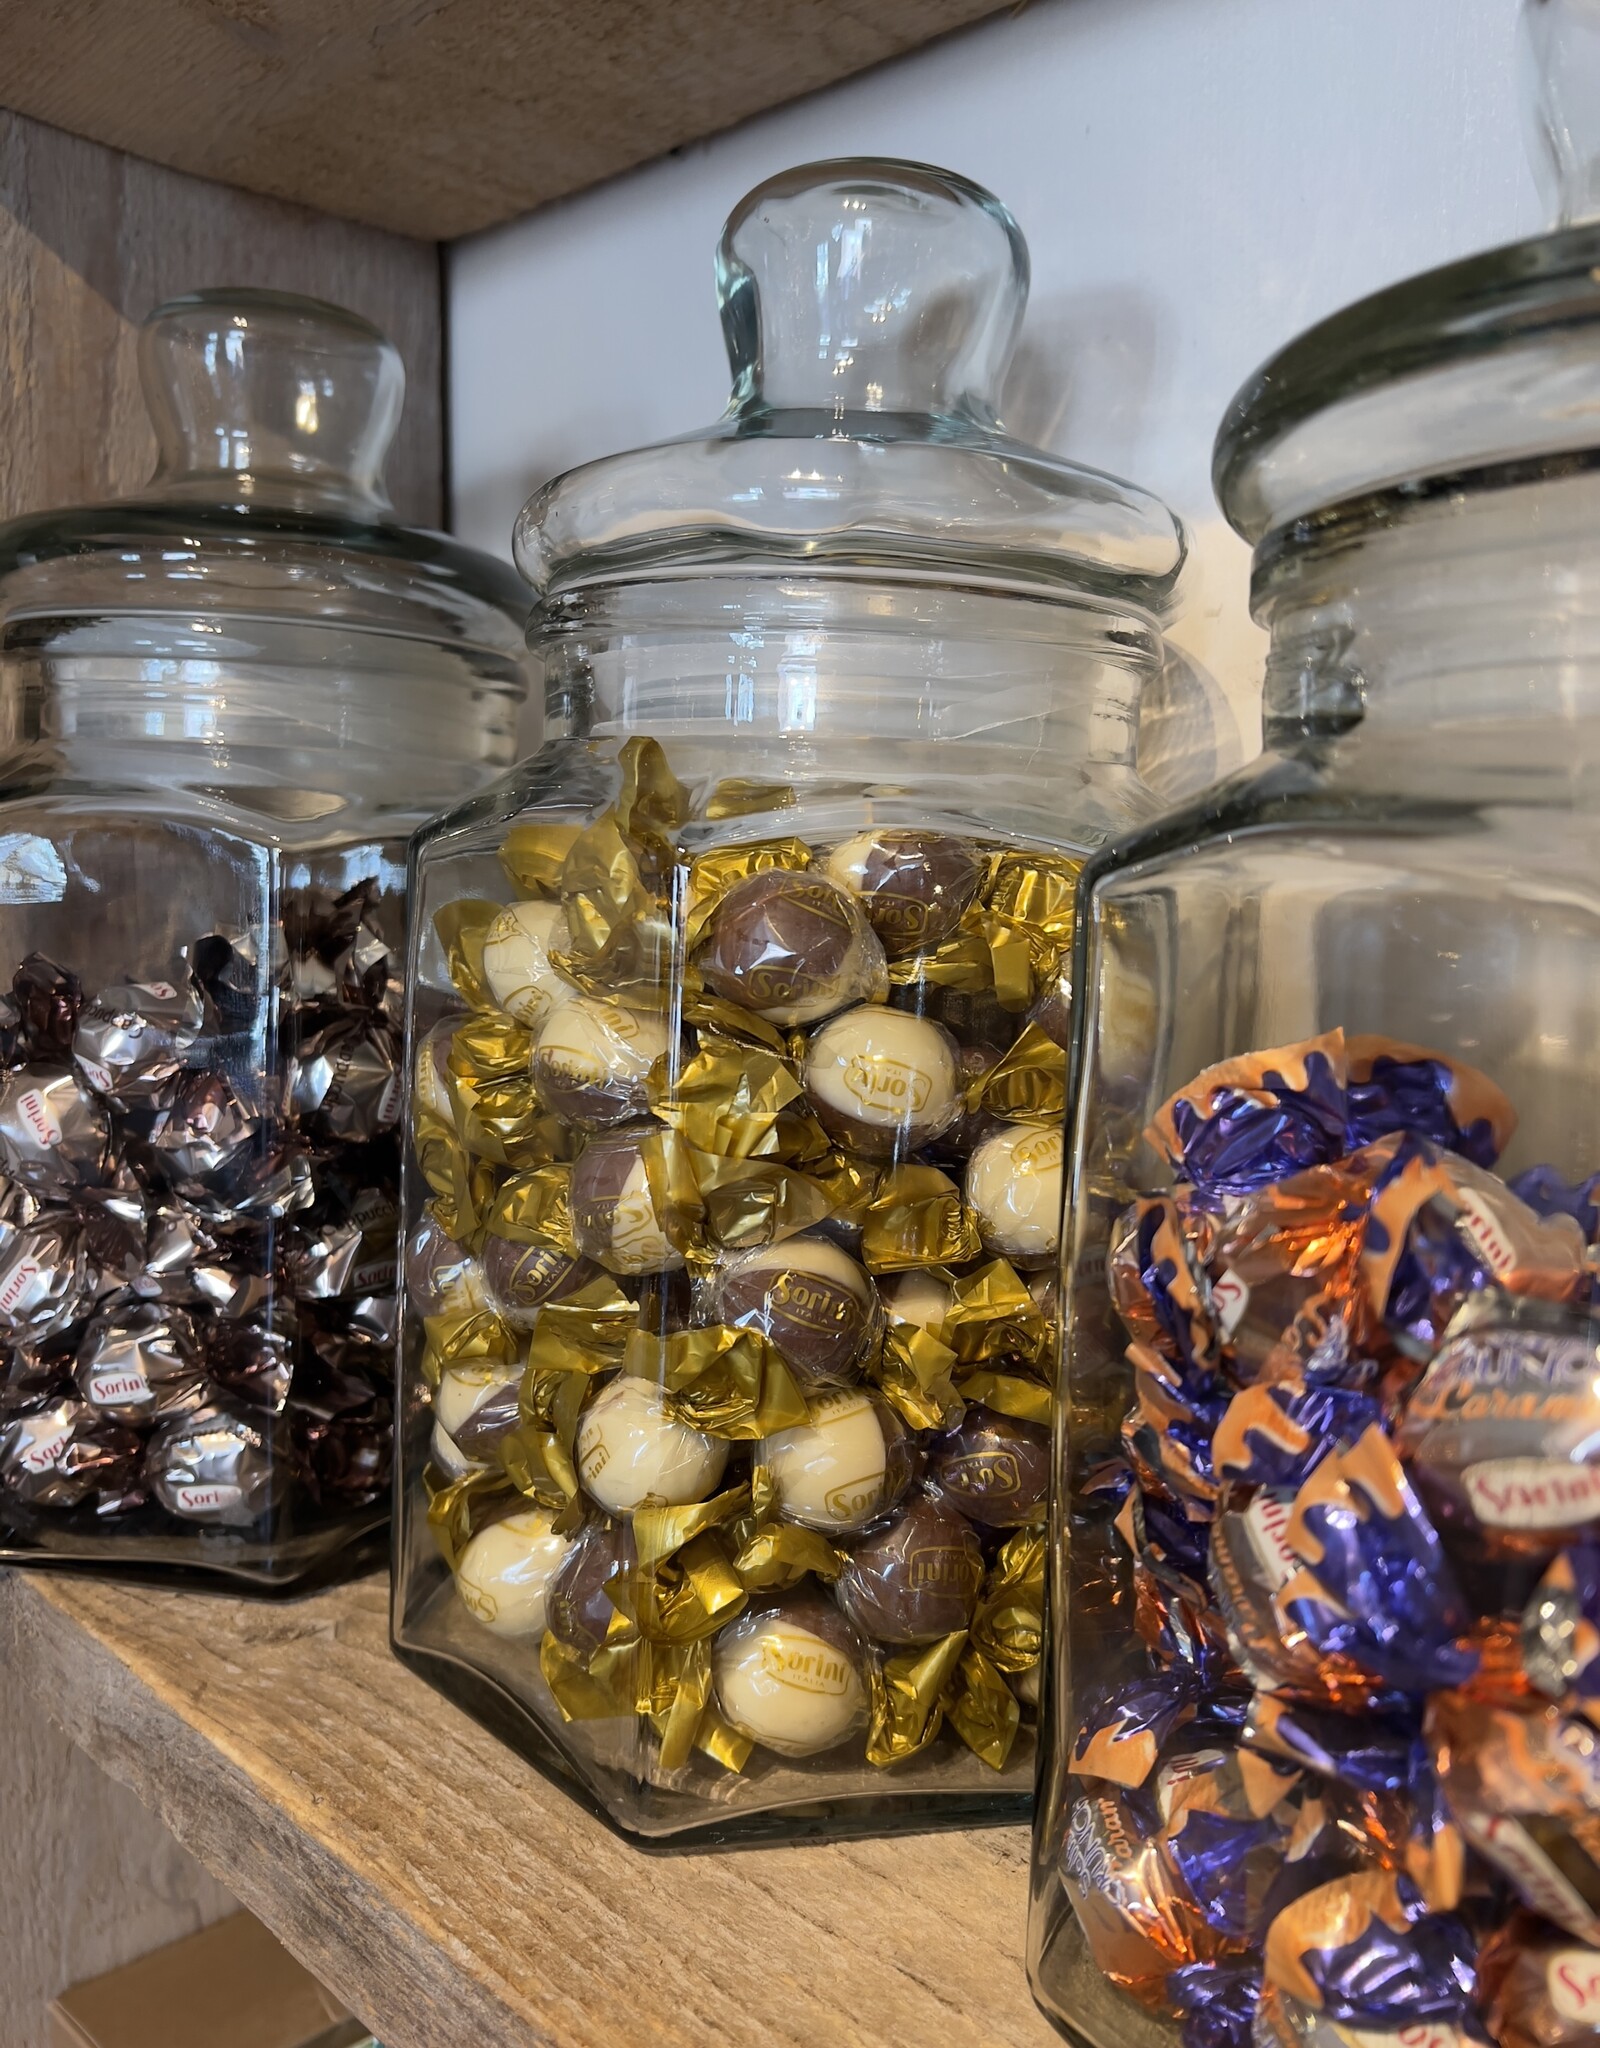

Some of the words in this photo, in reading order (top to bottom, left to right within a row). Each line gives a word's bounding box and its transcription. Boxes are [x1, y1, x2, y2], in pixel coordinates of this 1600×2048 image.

[30, 1435, 67, 1468] Sori
[181, 1491, 220, 1508] Sori
[1261, 1492, 1298, 1562] orini
[915, 1561, 970, 1584] orini
[761, 1641, 848, 1684] Sorini
[792, 1672, 826, 1688] ITALIA
